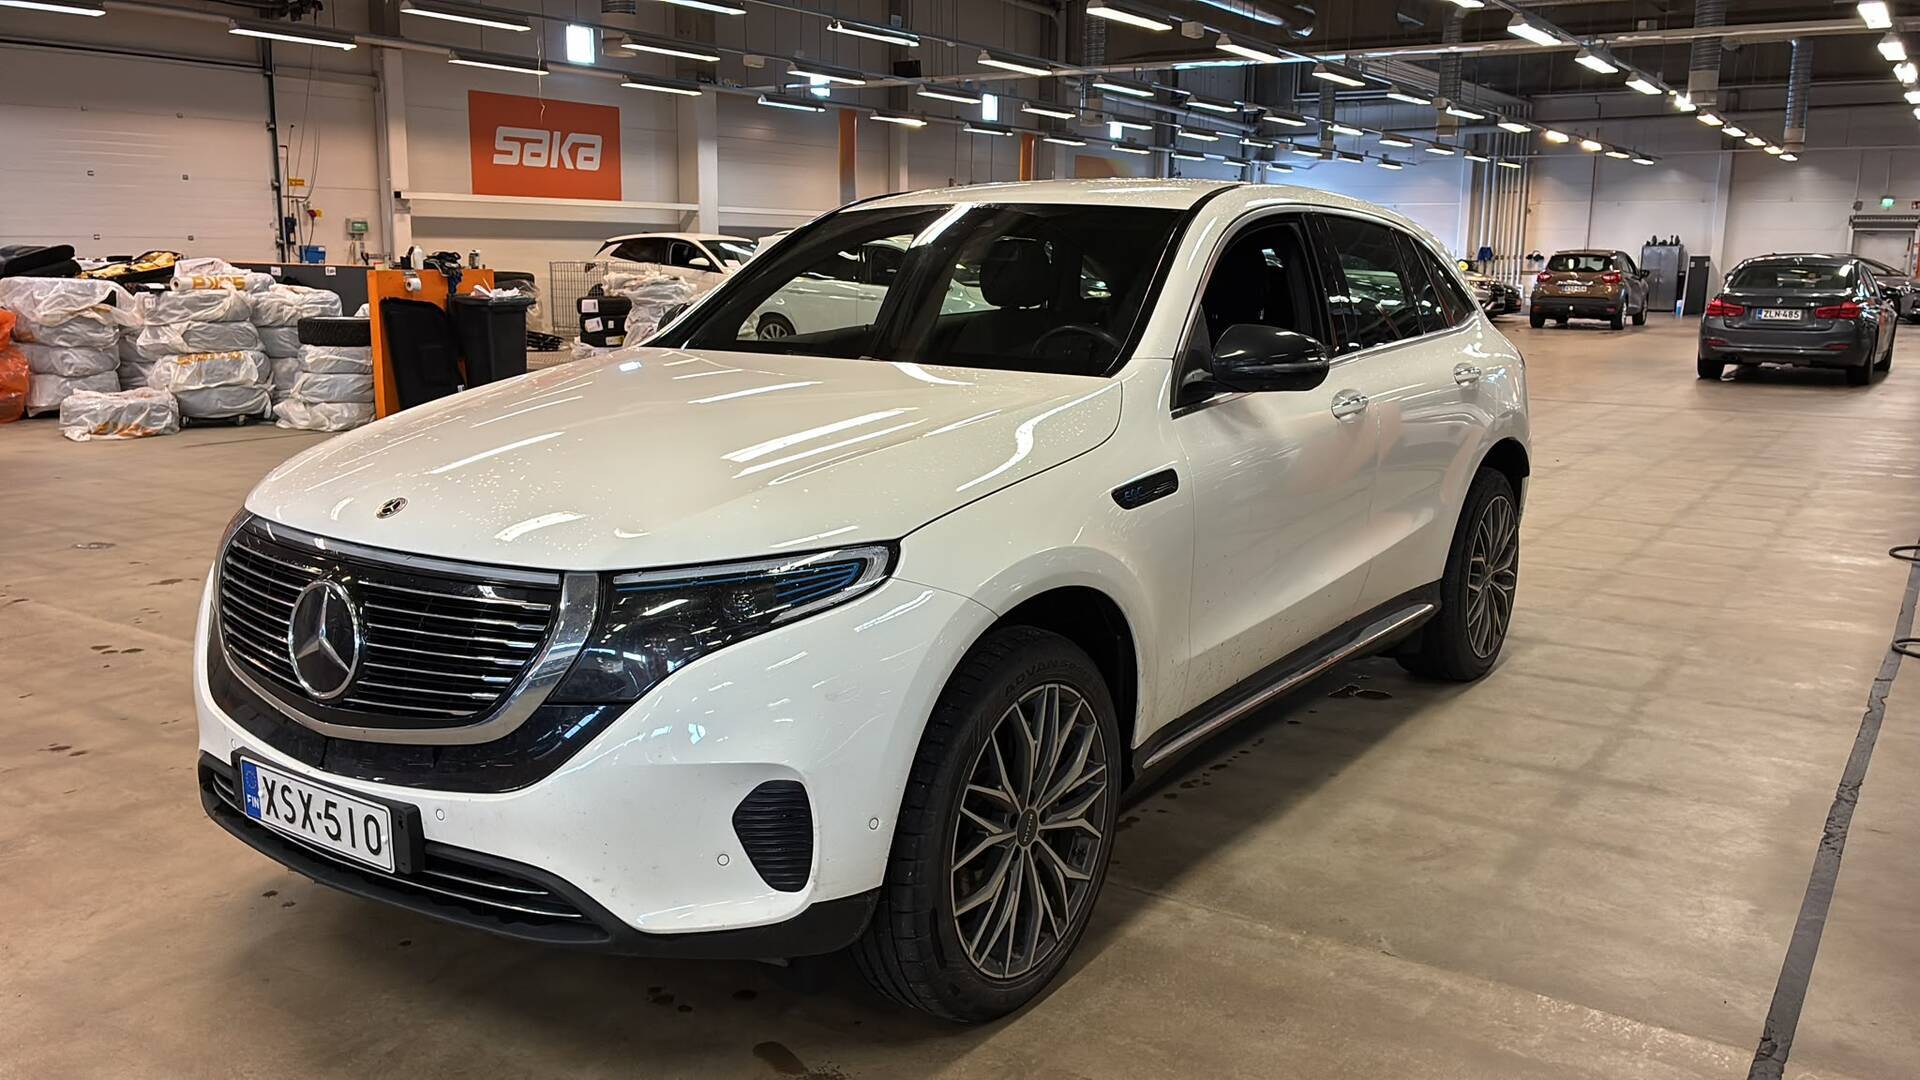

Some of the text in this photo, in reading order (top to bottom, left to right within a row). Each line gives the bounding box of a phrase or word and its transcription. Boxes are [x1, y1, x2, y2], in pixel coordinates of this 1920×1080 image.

[1763, 309, 1800, 319] ZLN-485
[247, 794, 260, 810] FIN
[262, 776, 382, 856] XSX-510
